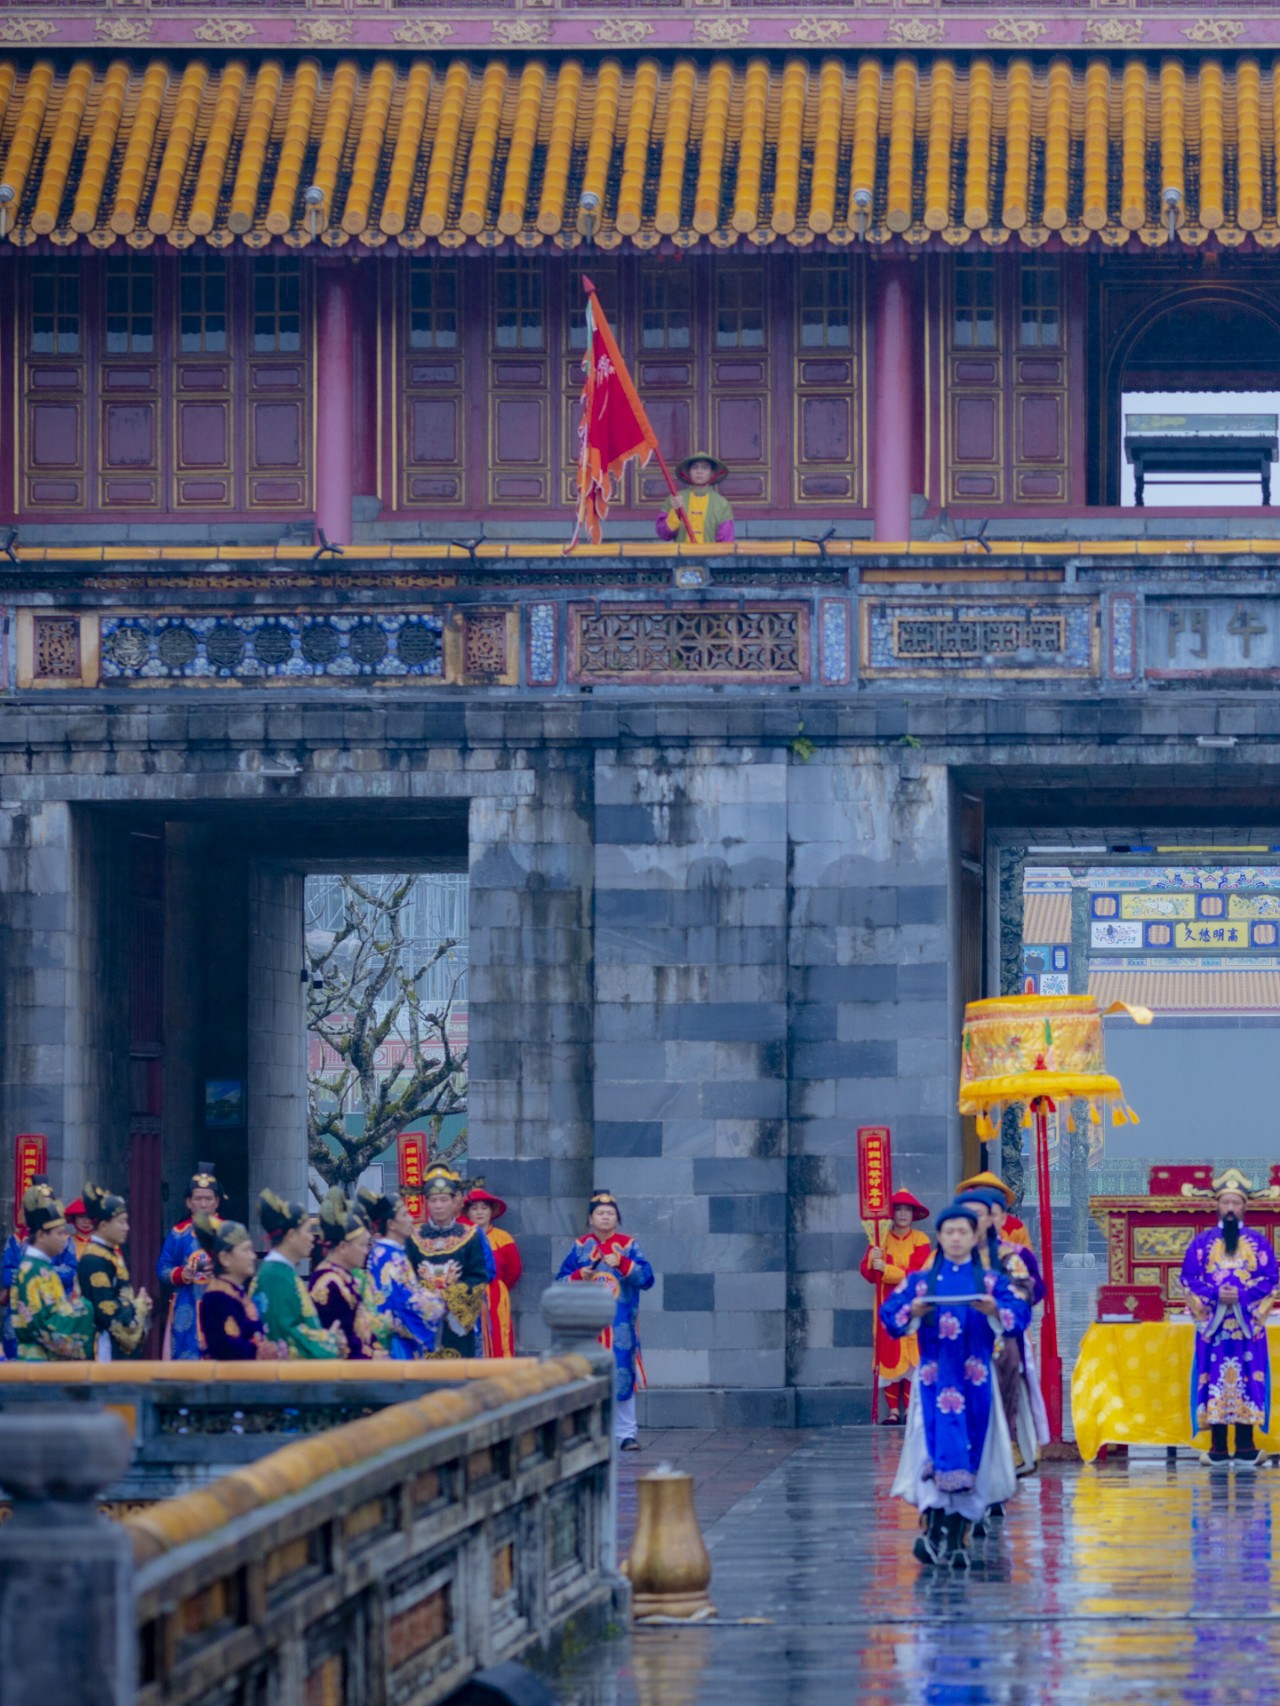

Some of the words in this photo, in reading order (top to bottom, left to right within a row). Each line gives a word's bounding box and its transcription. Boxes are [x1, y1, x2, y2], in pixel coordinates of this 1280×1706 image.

[1167, 605, 1268, 660] 午門
[1184, 927, 1239, 942] 高明悠久
